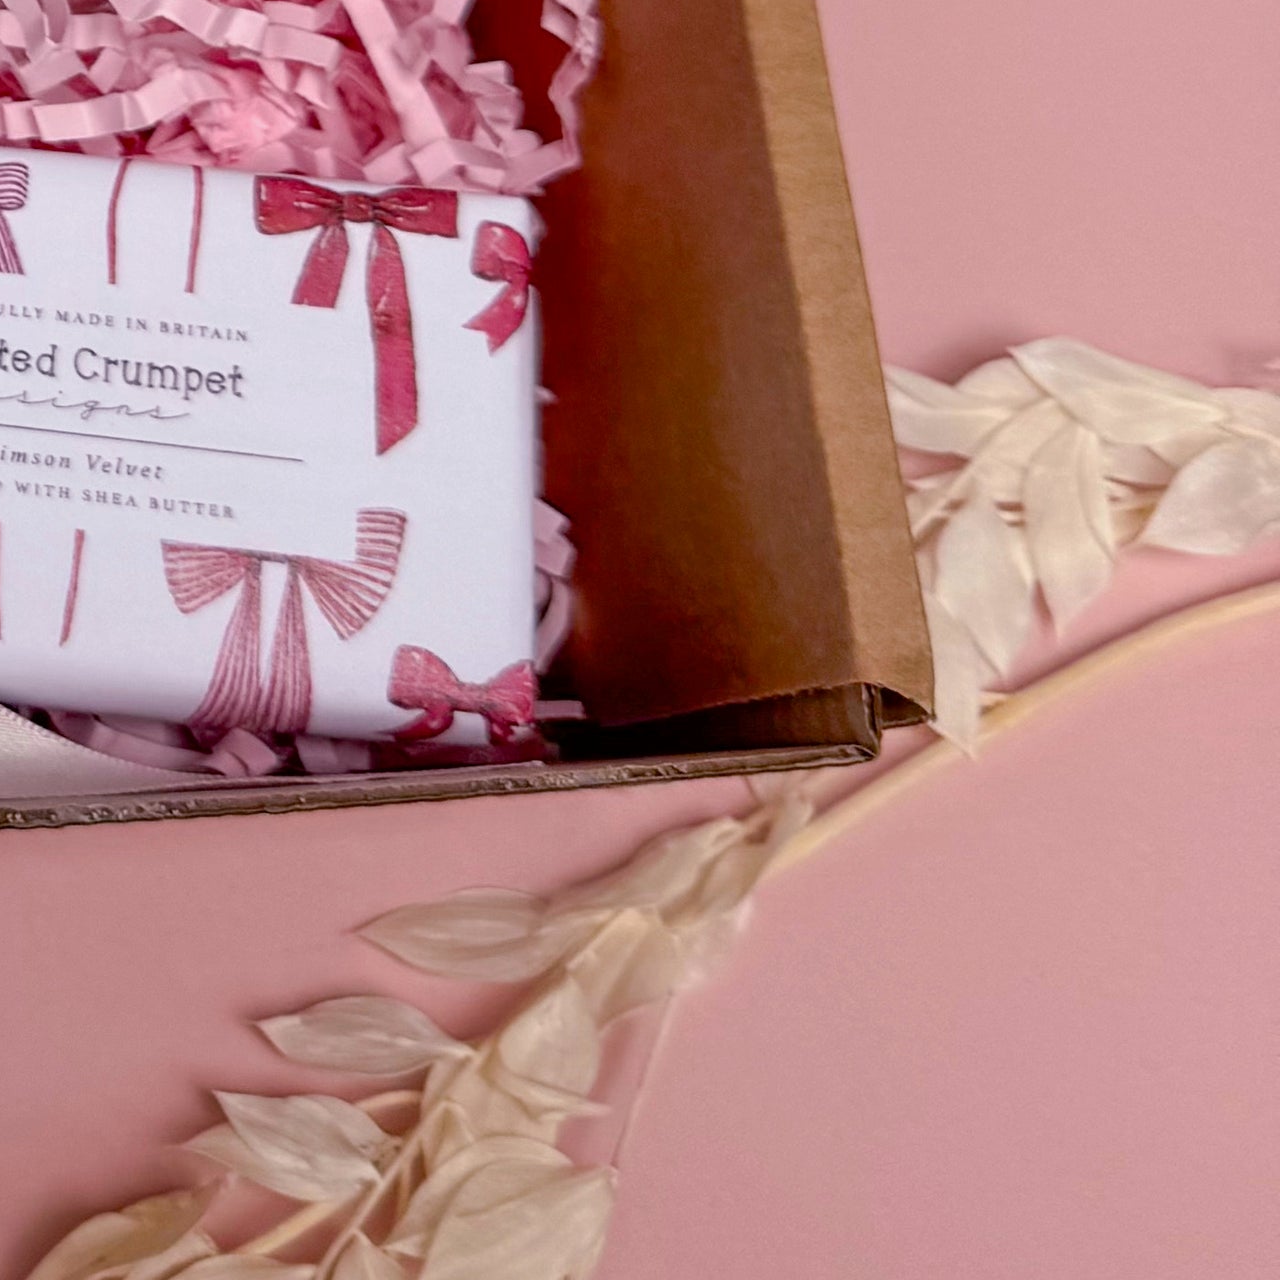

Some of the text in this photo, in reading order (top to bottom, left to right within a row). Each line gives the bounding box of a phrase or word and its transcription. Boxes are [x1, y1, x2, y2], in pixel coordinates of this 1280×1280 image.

[55, 308, 115, 328] MADE
[126, 317, 148, 332] IN
[159, 321, 249, 343] BRITAIN
[73, 346, 245, 401] Crumpet
[86, 453, 166, 481] Velvet
[15, 479, 71, 500] WITH
[82, 488, 139, 508] SHEA
[148, 496, 236, 519] BUTTER
